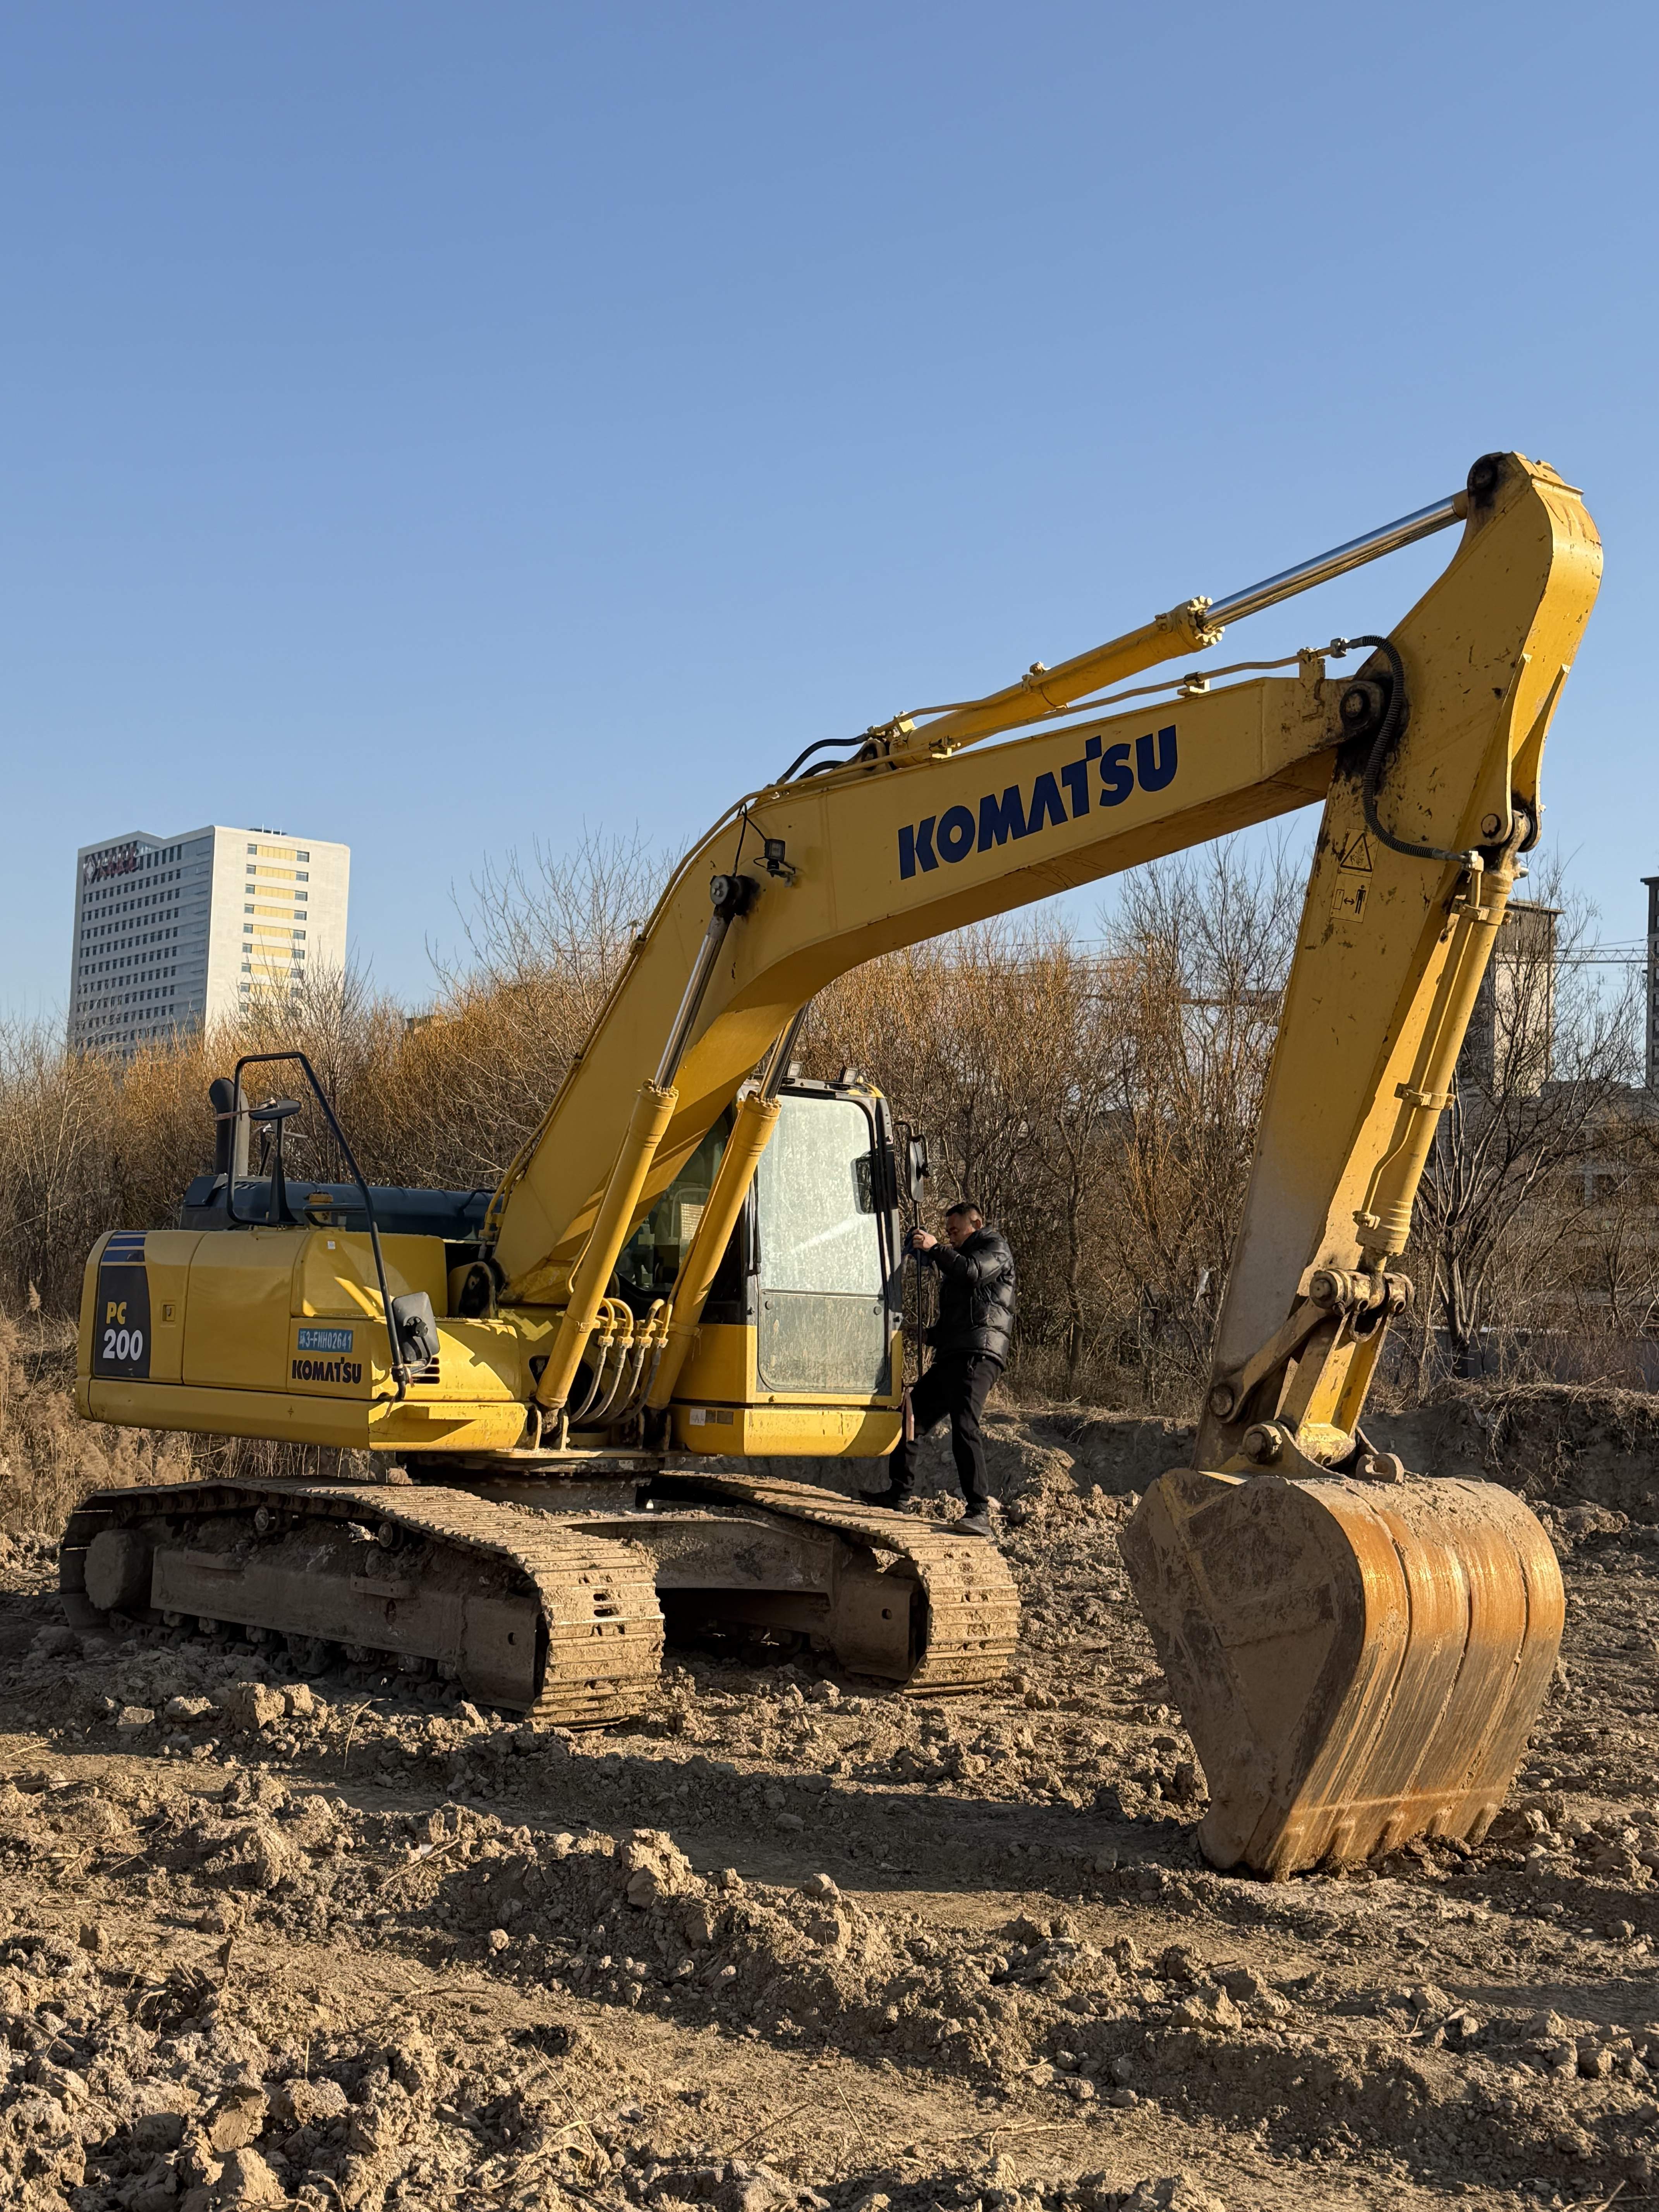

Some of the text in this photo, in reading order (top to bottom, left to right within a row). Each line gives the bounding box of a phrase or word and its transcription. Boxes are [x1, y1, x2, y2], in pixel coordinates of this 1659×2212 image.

[898, 724, 1178, 880] KOMATSU
[106, 1302, 127, 1324] PC
[103, 1329, 143, 1361] 200
[292, 1357, 362, 1384] KOMATSU
